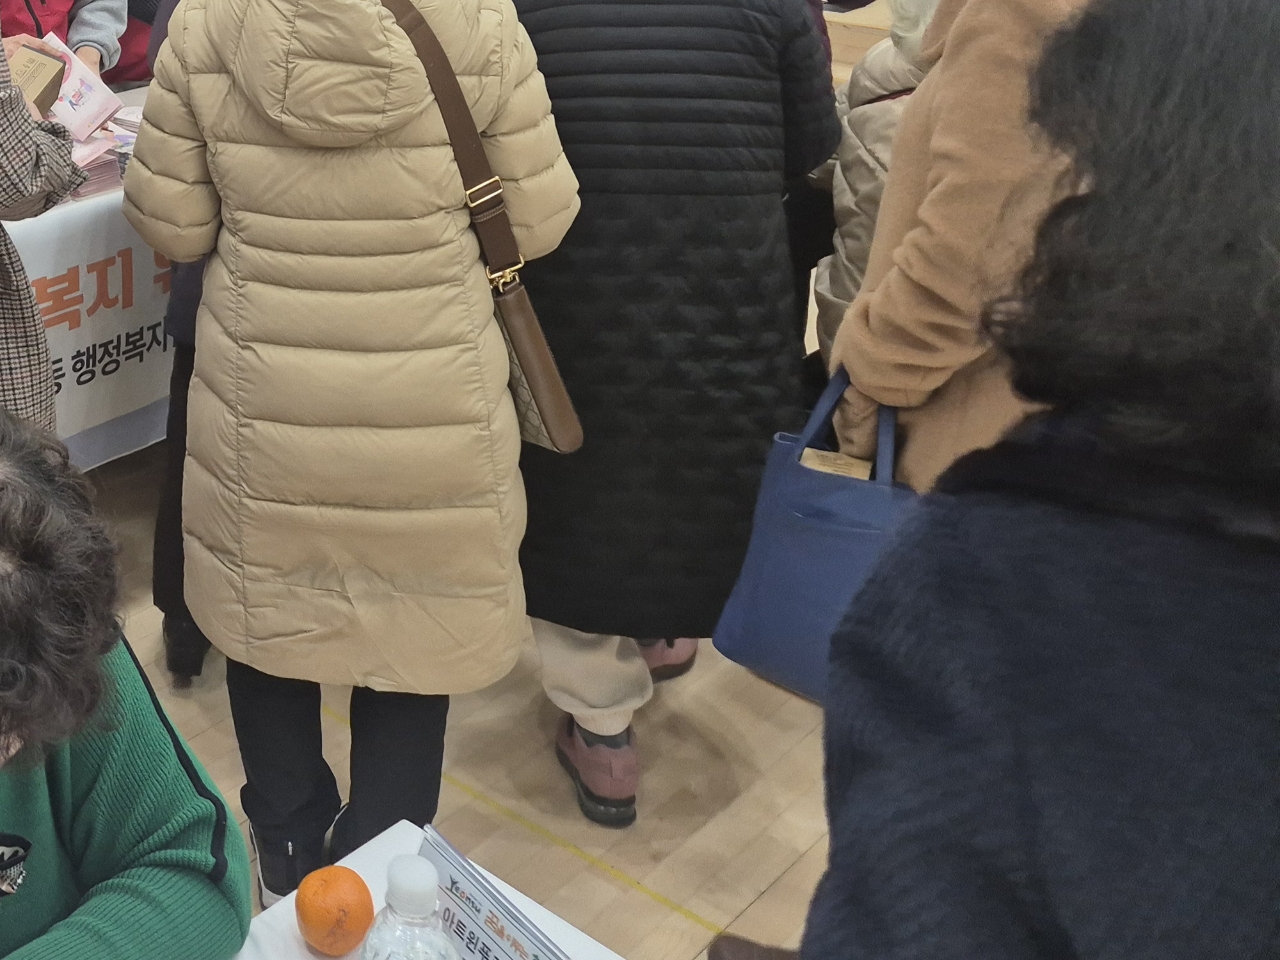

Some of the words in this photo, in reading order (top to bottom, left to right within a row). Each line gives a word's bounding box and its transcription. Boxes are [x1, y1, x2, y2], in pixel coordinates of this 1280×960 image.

[31, 246, 134, 331] 복지
[71, 316, 170, 386] 행정복지
[445, 874, 483, 915] Yeonsu
